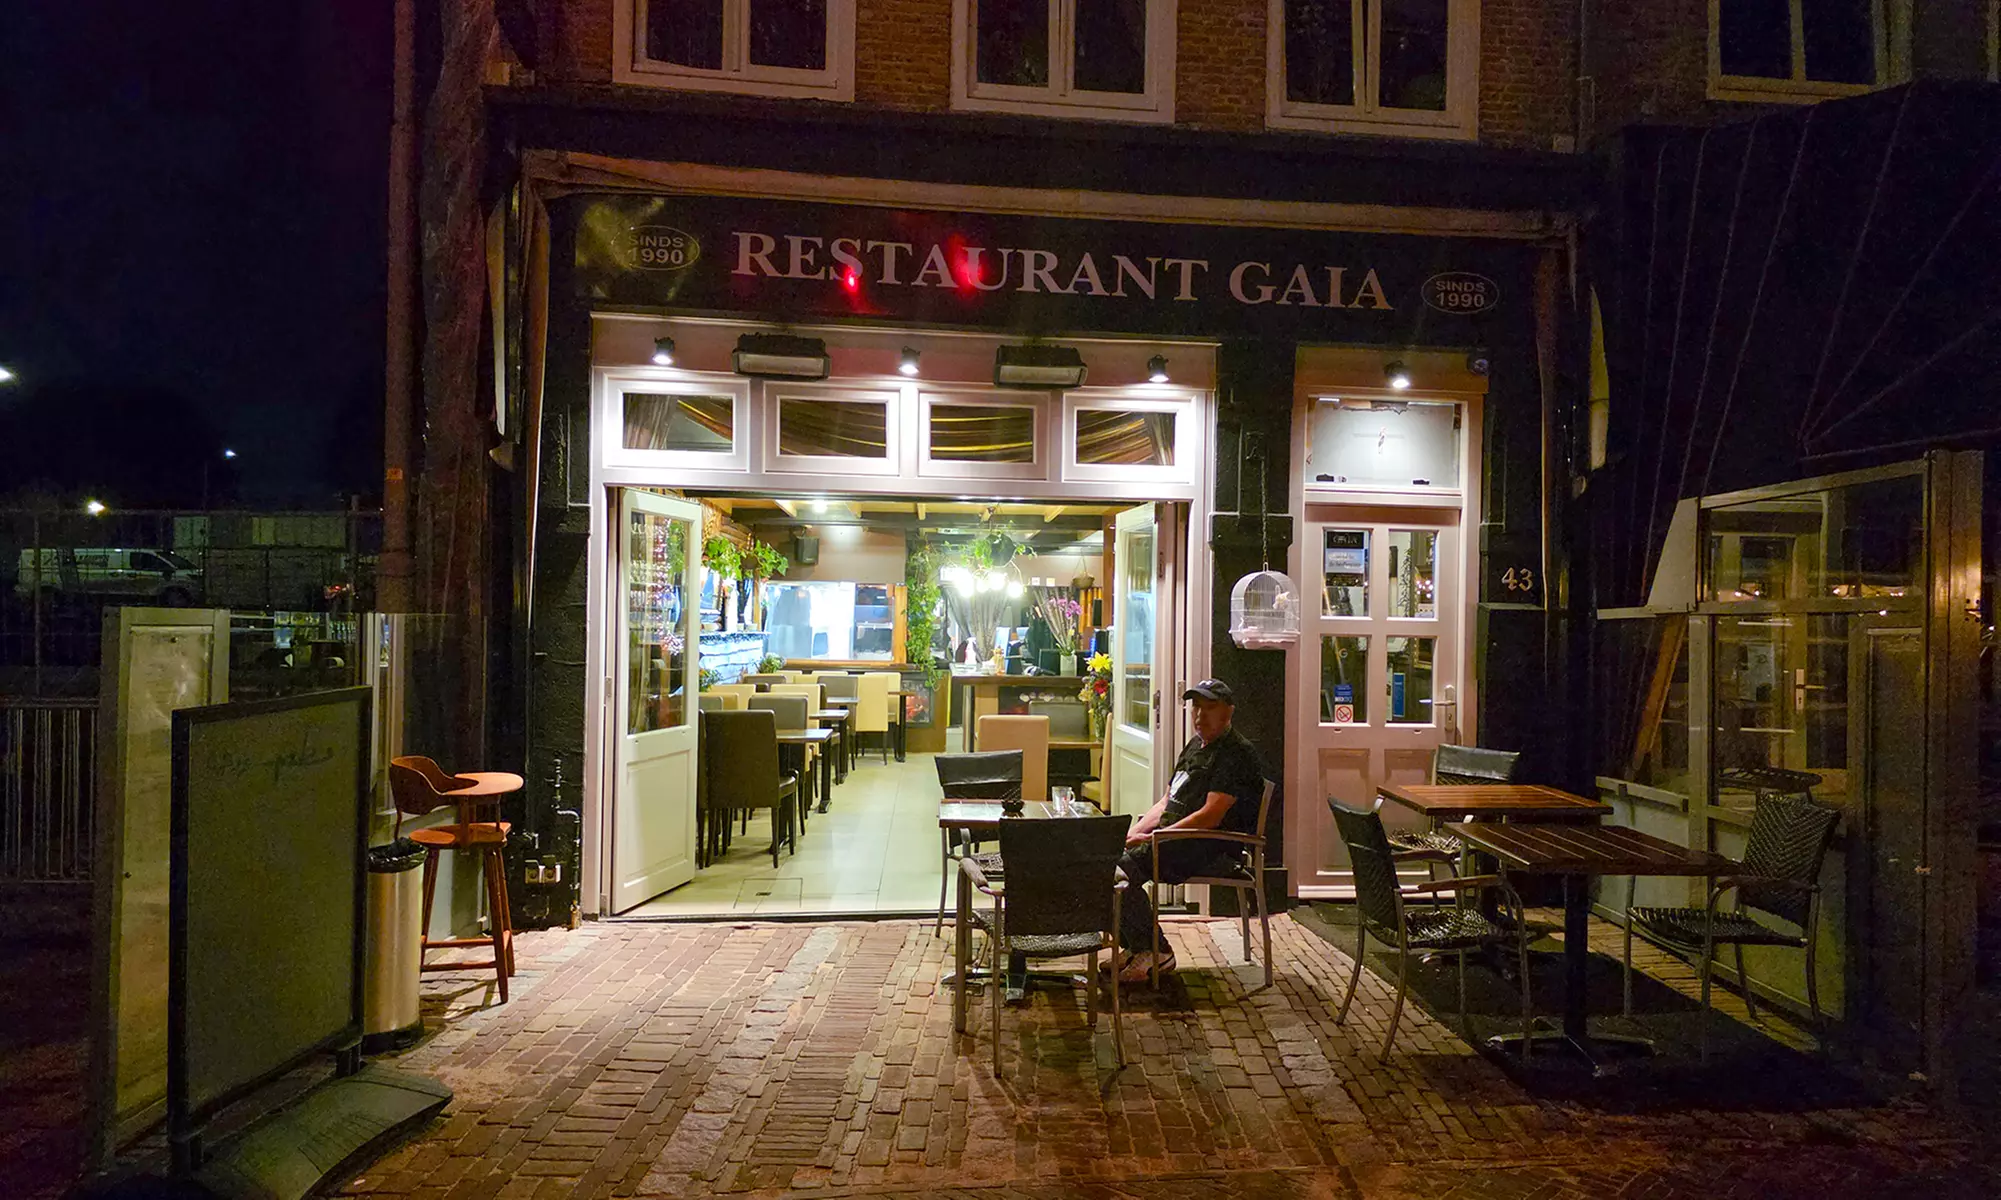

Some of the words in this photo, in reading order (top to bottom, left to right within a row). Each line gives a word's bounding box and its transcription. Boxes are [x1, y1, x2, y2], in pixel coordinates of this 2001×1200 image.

[628, 235, 685, 249] SINDS
[628, 247, 684, 265] 1990
[731, 231, 1208, 301] RESTAURANT
[1229, 261, 1395, 311] GAIA
[1435, 280, 1485, 293] SINDS
[1435, 292, 1485, 308] 1990
[1501, 566, 1533, 591] 43
